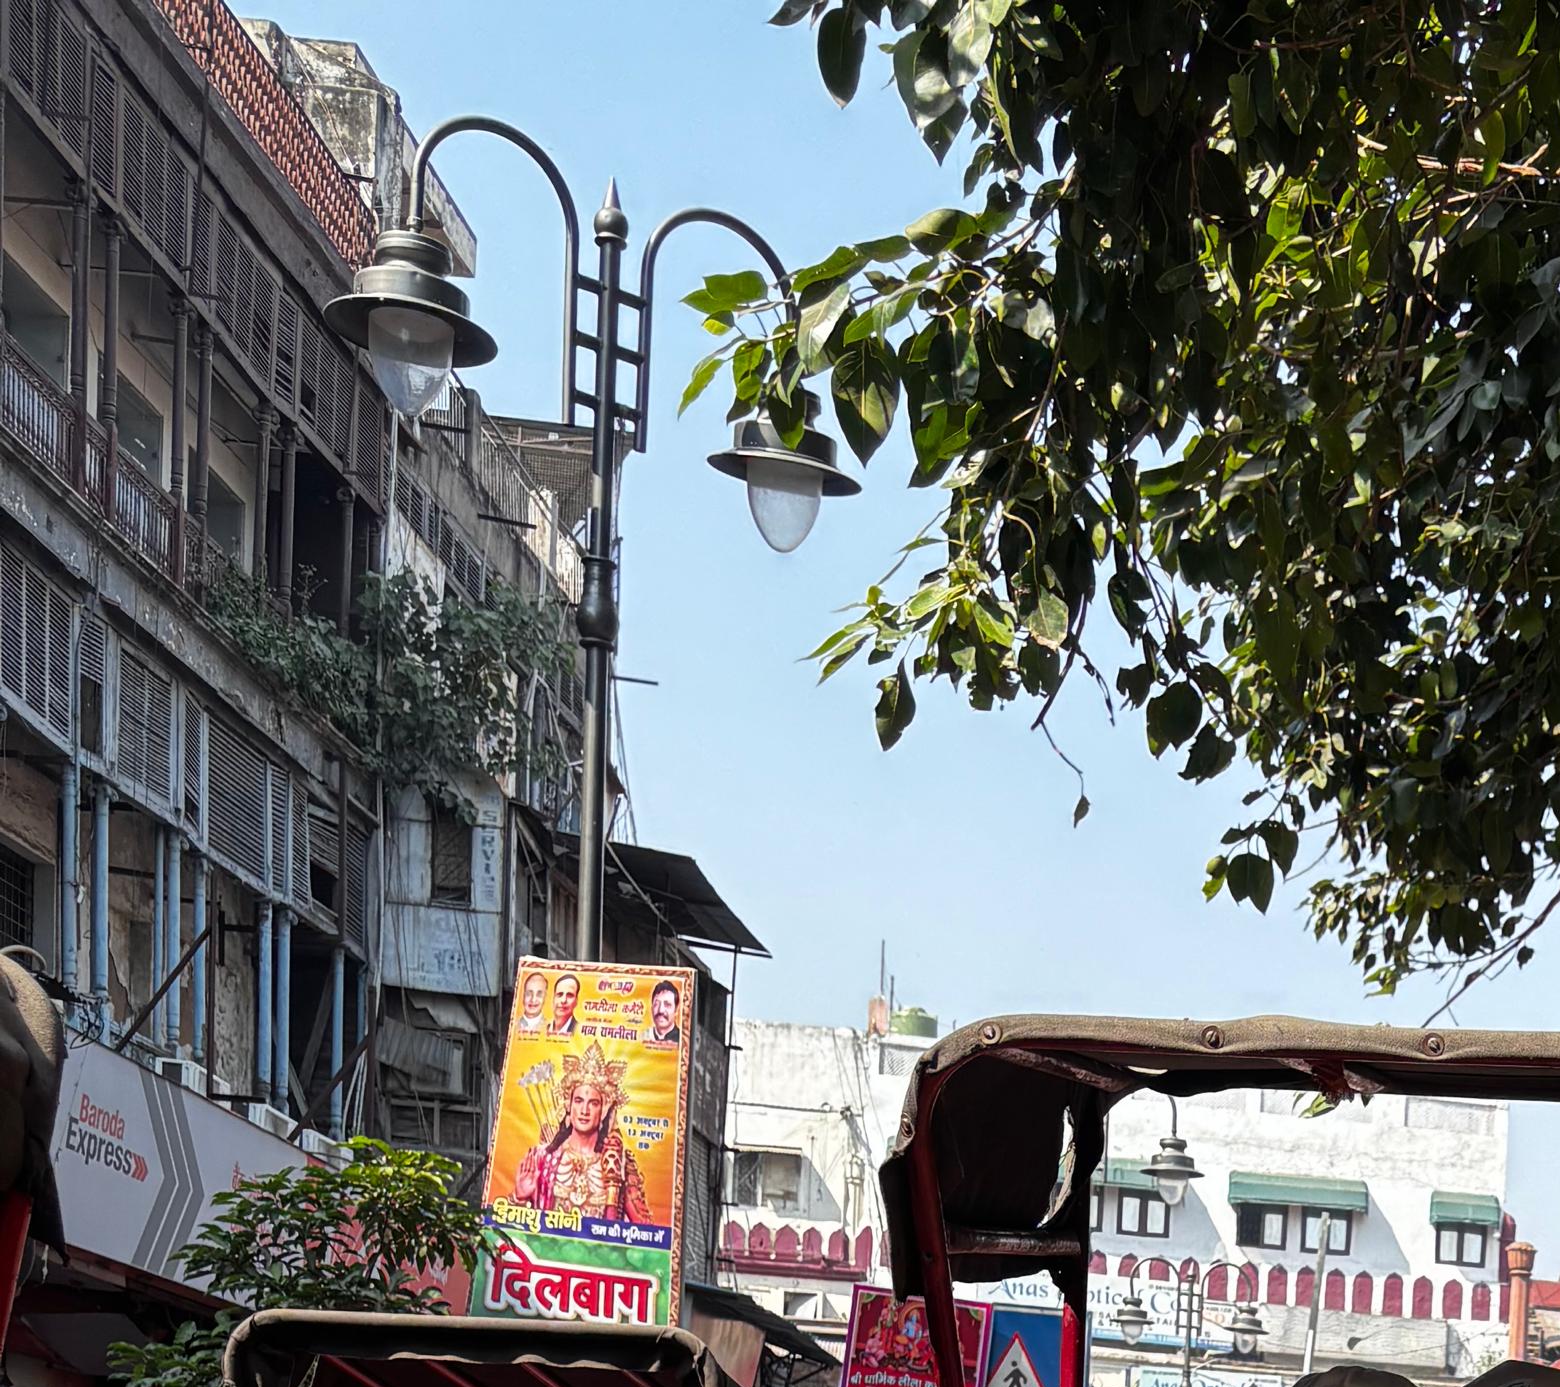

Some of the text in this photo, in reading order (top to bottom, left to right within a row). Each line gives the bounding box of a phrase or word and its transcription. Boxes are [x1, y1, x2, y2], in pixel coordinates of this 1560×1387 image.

[79, 1093, 125, 1140] Baroda
[65, 1115, 133, 1177] Express
[544, 1206, 583, 1232] सोनी
[491, 1244, 653, 1323] दिलबाग
[988, 1279, 1050, 1300] Anas
[864, 1370, 897, 1386] धार्मिक
